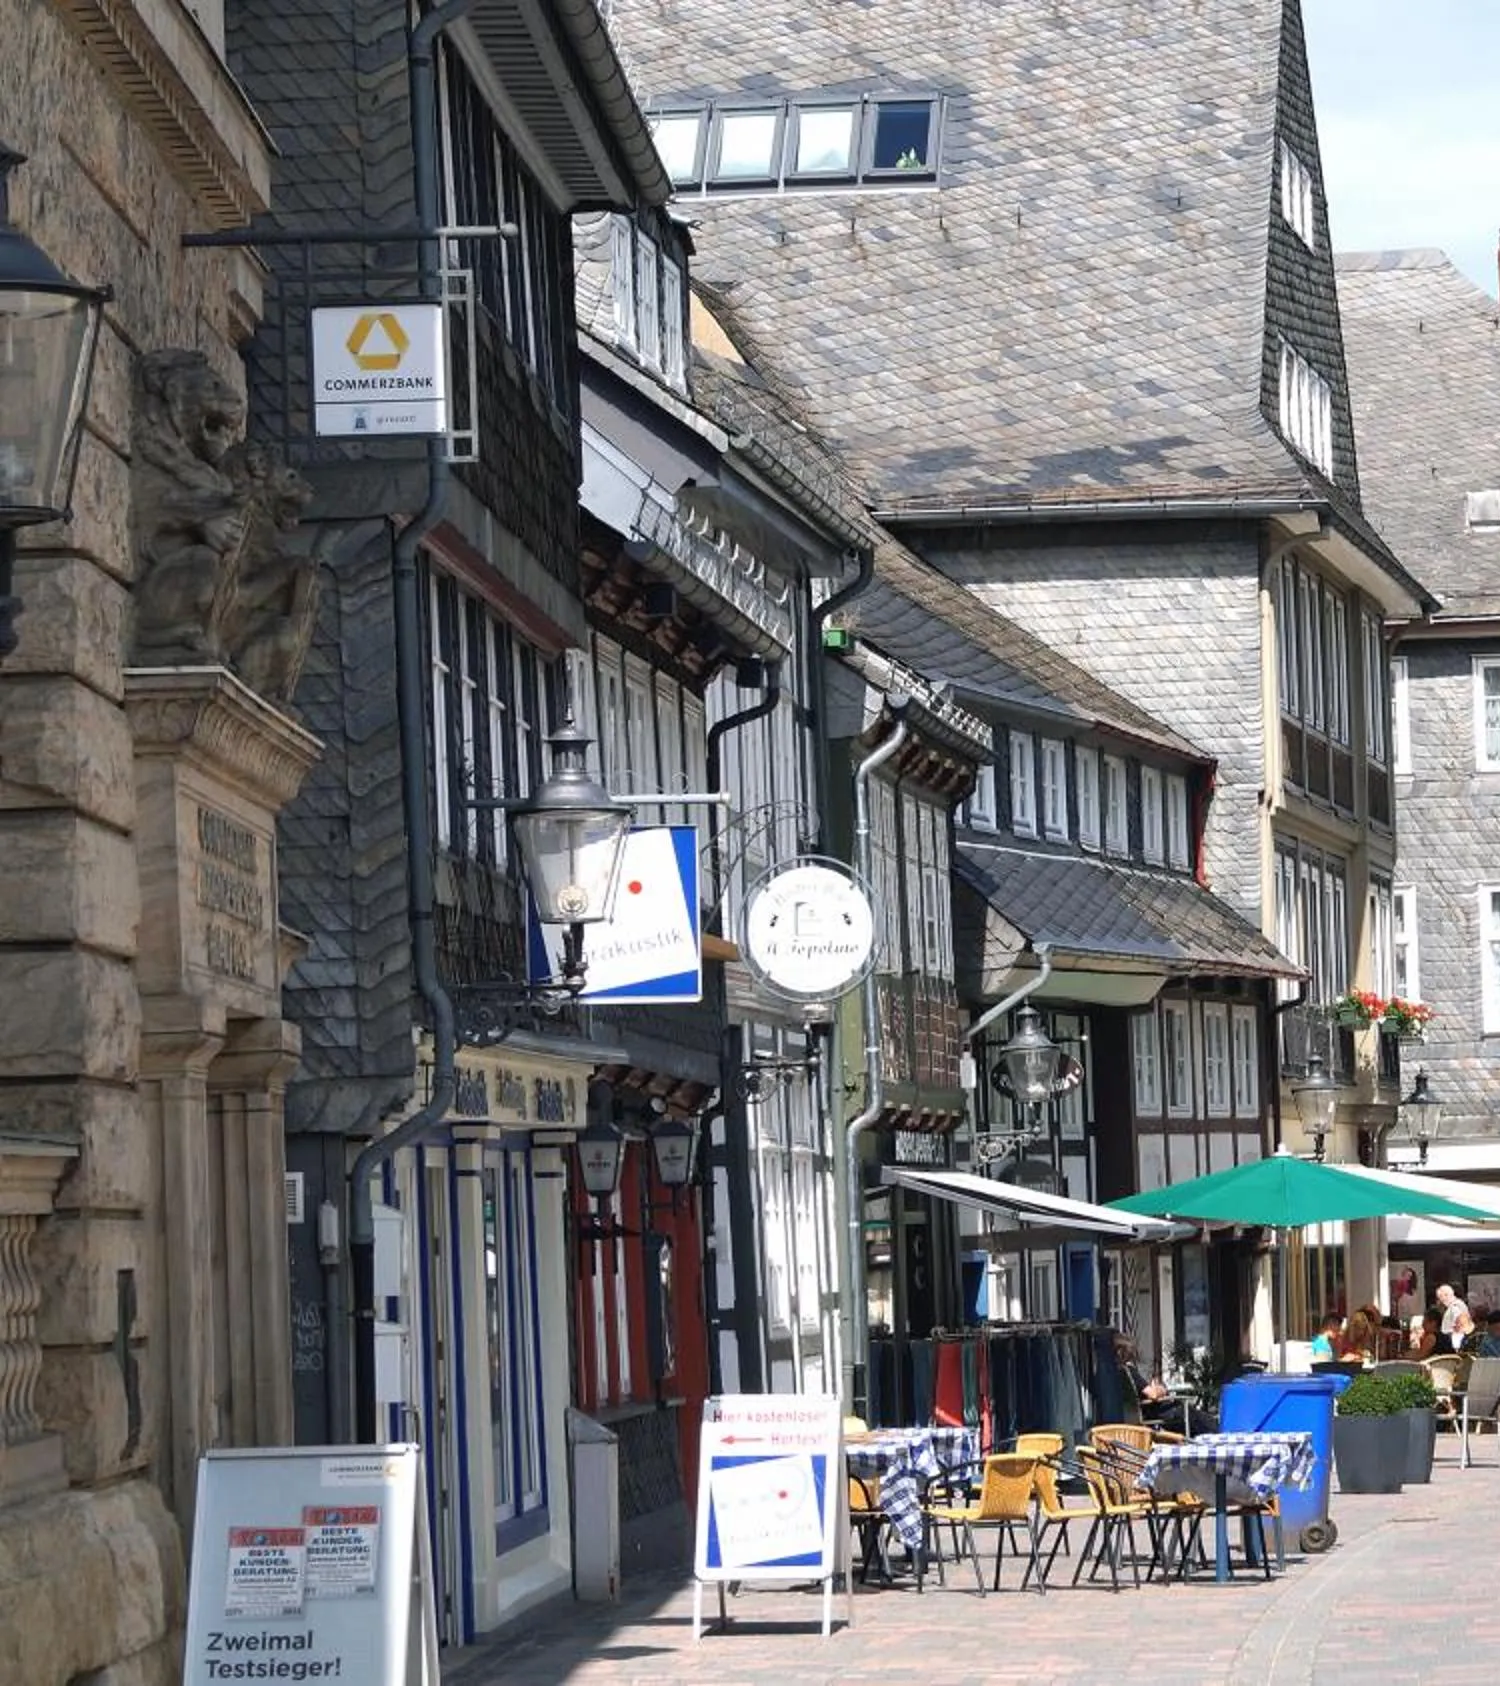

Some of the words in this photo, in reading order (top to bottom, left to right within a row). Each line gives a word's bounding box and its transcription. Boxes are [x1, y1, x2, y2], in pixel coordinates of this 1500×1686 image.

[324, 376, 433, 391] COMMERZBANK
[473, 1066, 496, 1092] H
[207, 1631, 314, 1651] Zweimal
[205, 1657, 342, 1681] Testsieger!
